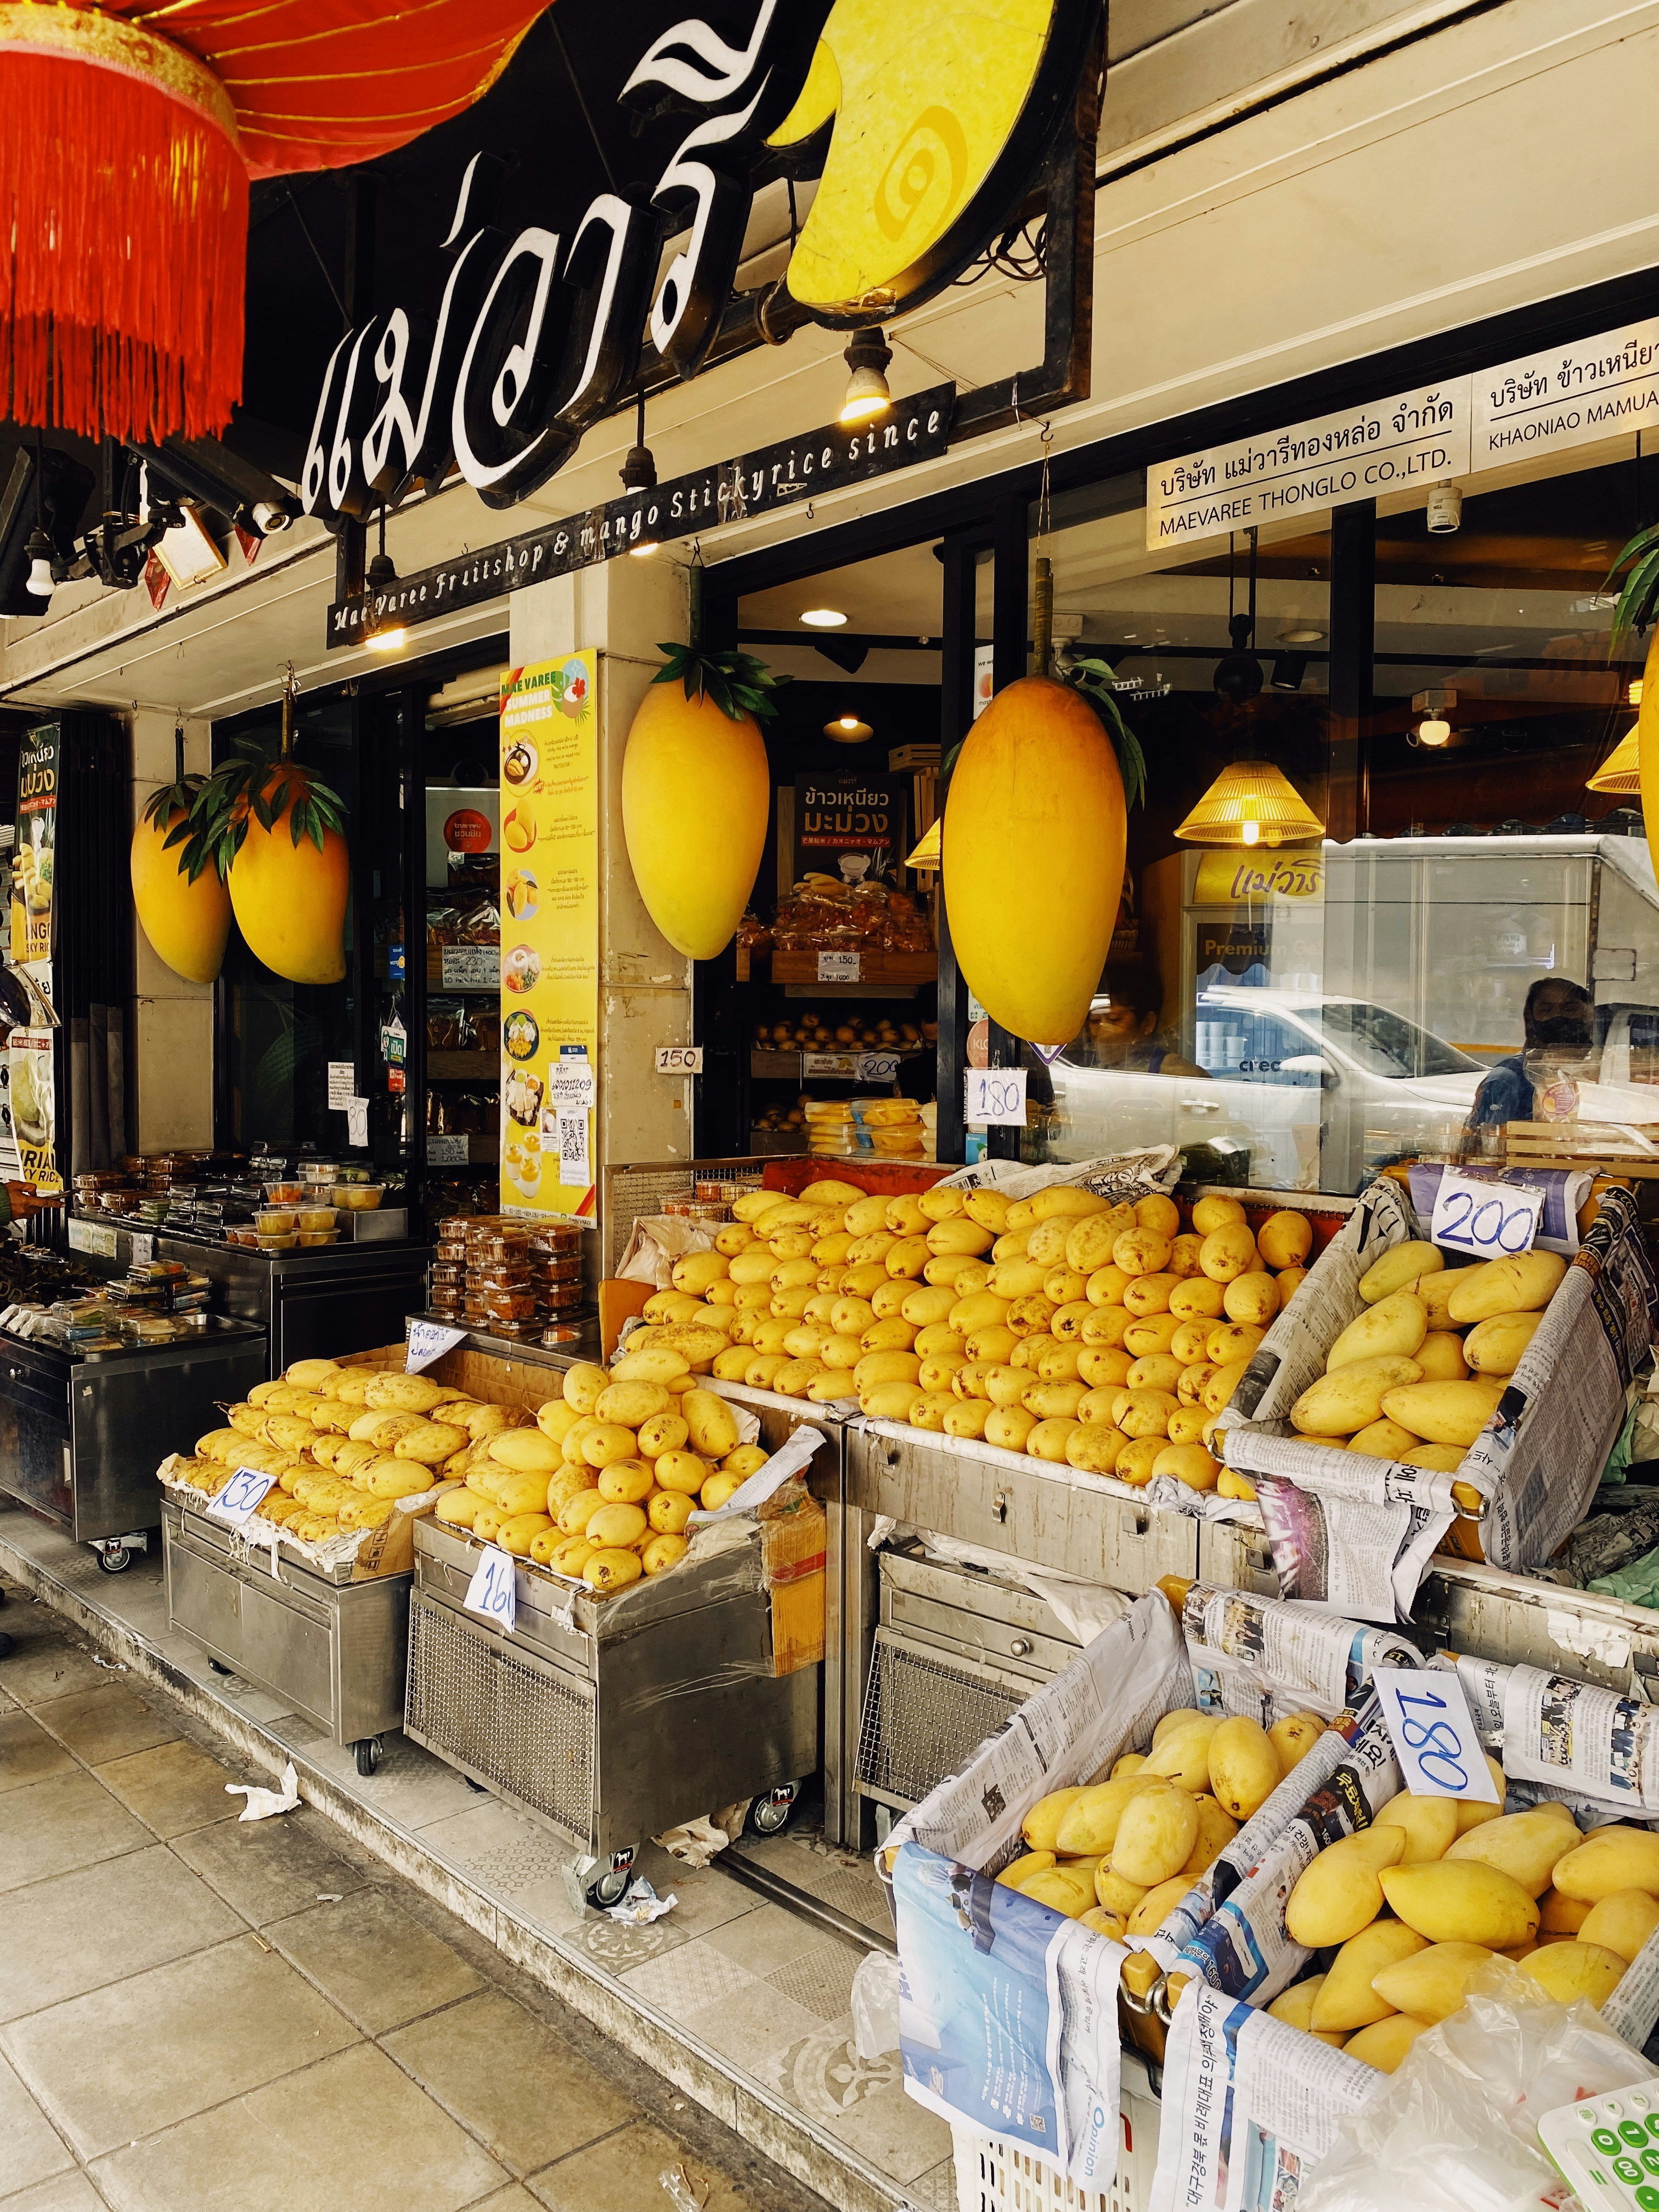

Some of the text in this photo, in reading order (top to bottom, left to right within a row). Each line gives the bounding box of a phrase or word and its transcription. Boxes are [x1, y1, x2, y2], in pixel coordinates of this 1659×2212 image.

[1491, 368, 1549, 409] บริษัท
[1160, 393, 1455, 498] บริษัท แม่วารีทองหล่อ จำกัด
[1489, 411, 1581, 451] KHAONIAO
[554, 531, 569, 555] &
[579, 504, 659, 546] mango
[849, 409, 940, 461] since
[1159, 447, 1452, 538] MAEVAREE THONGLO CO.,LTD.
[501, 671, 556, 695] MAE VAREE
[506, 689, 551, 712] SUMMER
[504, 705, 552, 728] MADNESS
[805, 786, 889, 806] ข้าวเหนียว
[804, 805, 889, 833] มะม่วง
[1204, 939, 1288, 957] Premium
[660, 1048, 696, 1068] 150
[976, 1078, 1020, 1116] 180
[1436, 1192, 1534, 1254] 200
[212, 1470, 272, 1511] 130
[1485, 1679, 1503, 1719] 오늘부터
[1395, 1688, 1469, 1792] 180
[1194, 2075, 1214, 2131] 비례대표
[1085, 2106, 1105, 2180] Opinion
[1598, 2134, 1613, 2146] 0
[1617, 2160, 1638, 2177] 00
